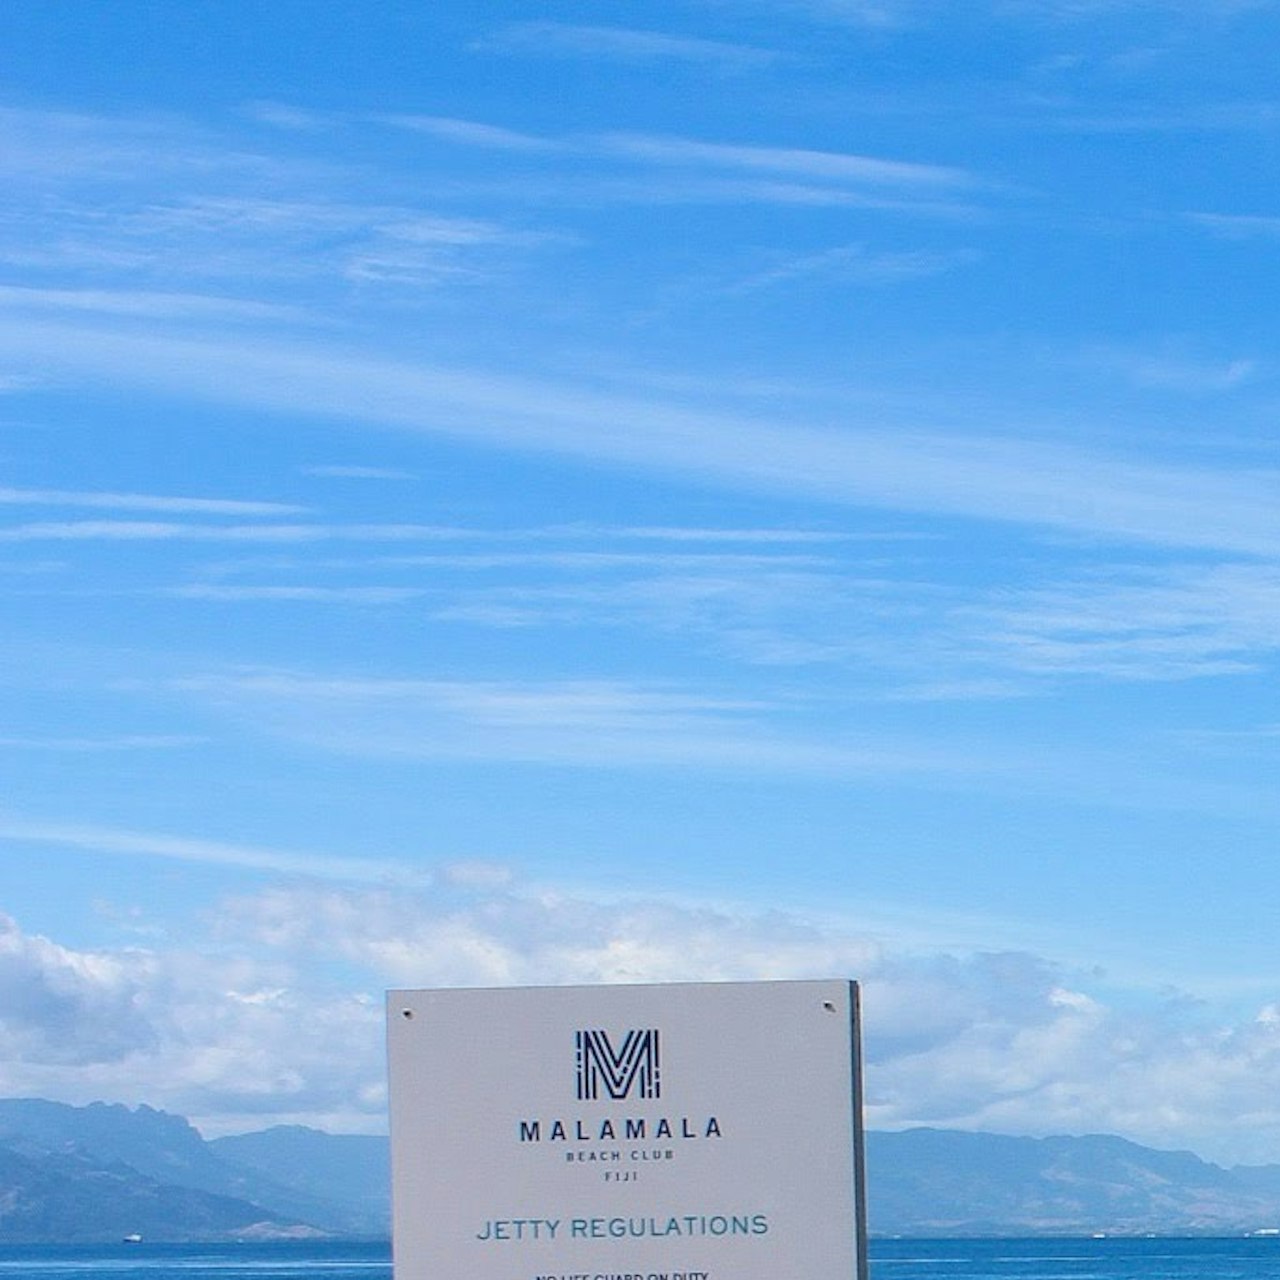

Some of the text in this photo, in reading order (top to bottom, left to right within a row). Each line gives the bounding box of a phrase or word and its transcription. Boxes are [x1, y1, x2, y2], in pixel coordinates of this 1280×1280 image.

[518, 1116, 722, 1143] MALAMALA
[565, 1149, 673, 1163] BEACH CLUB
[604, 1171, 637, 1182] FIJI
[475, 1214, 769, 1241] JETTY REGULATIONS
